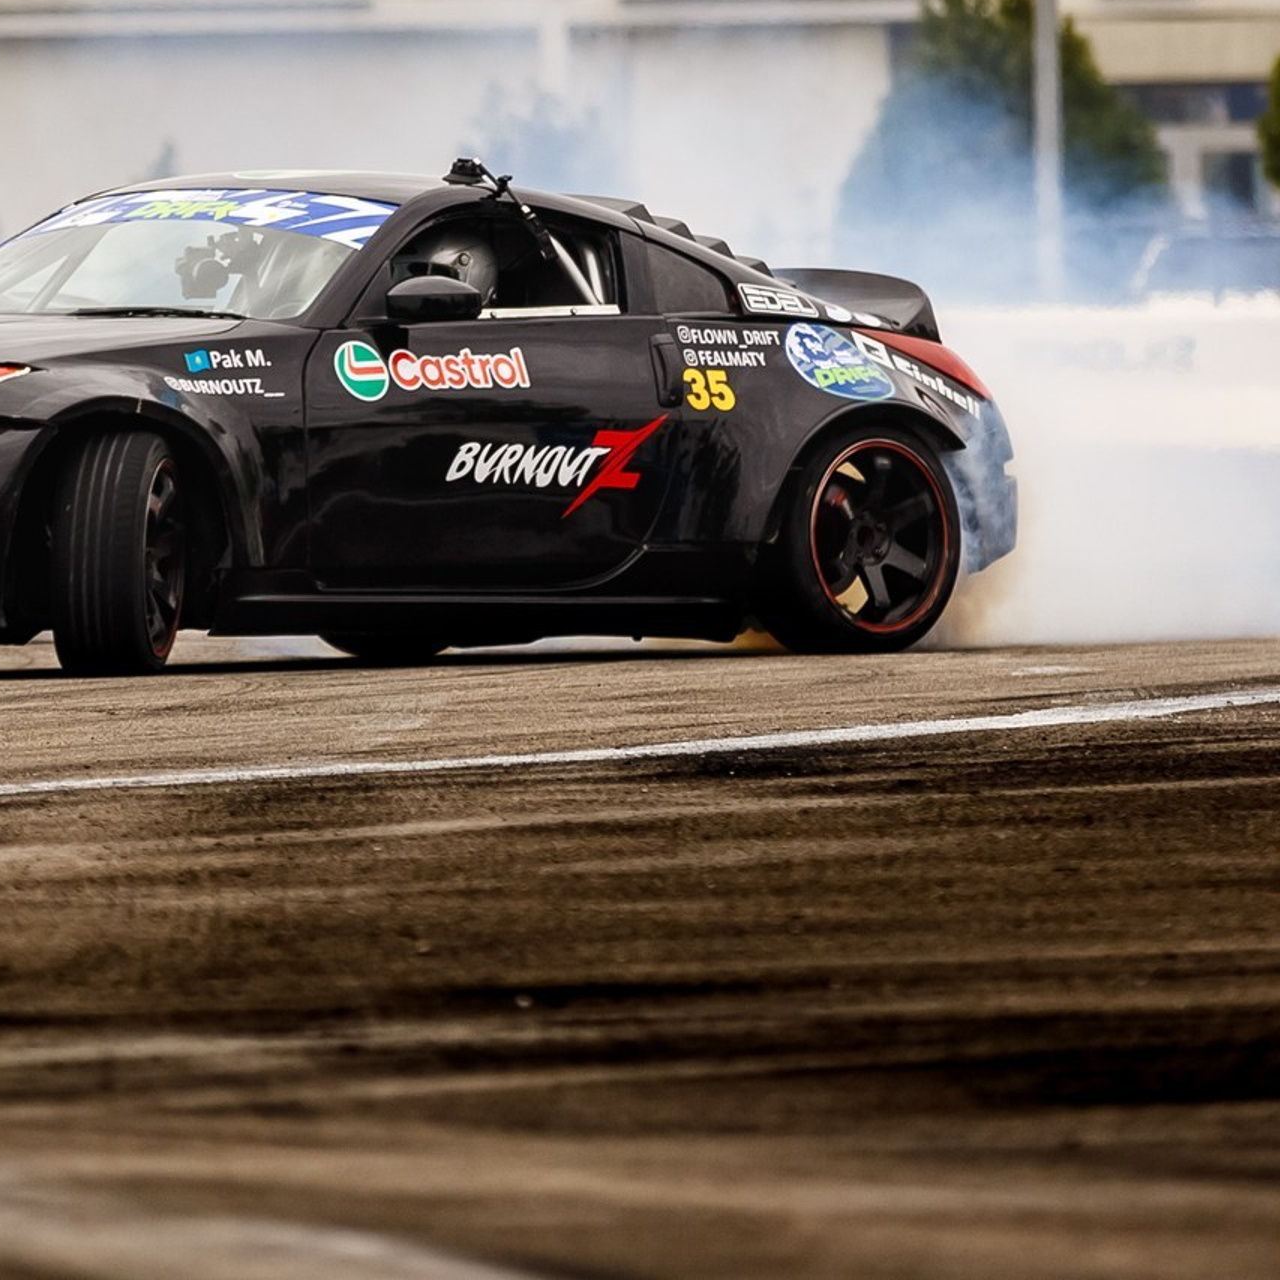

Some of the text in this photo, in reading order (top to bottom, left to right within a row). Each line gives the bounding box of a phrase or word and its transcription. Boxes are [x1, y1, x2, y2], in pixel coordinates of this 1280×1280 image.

[677, 325, 781, 349] @FLOWN_DRIFT
[209, 350, 272, 369] Pak M.
[388, 347, 531, 390] Castrol
[683, 348, 767, 367] @FEALMATY
[683, 368, 736, 412] 35
